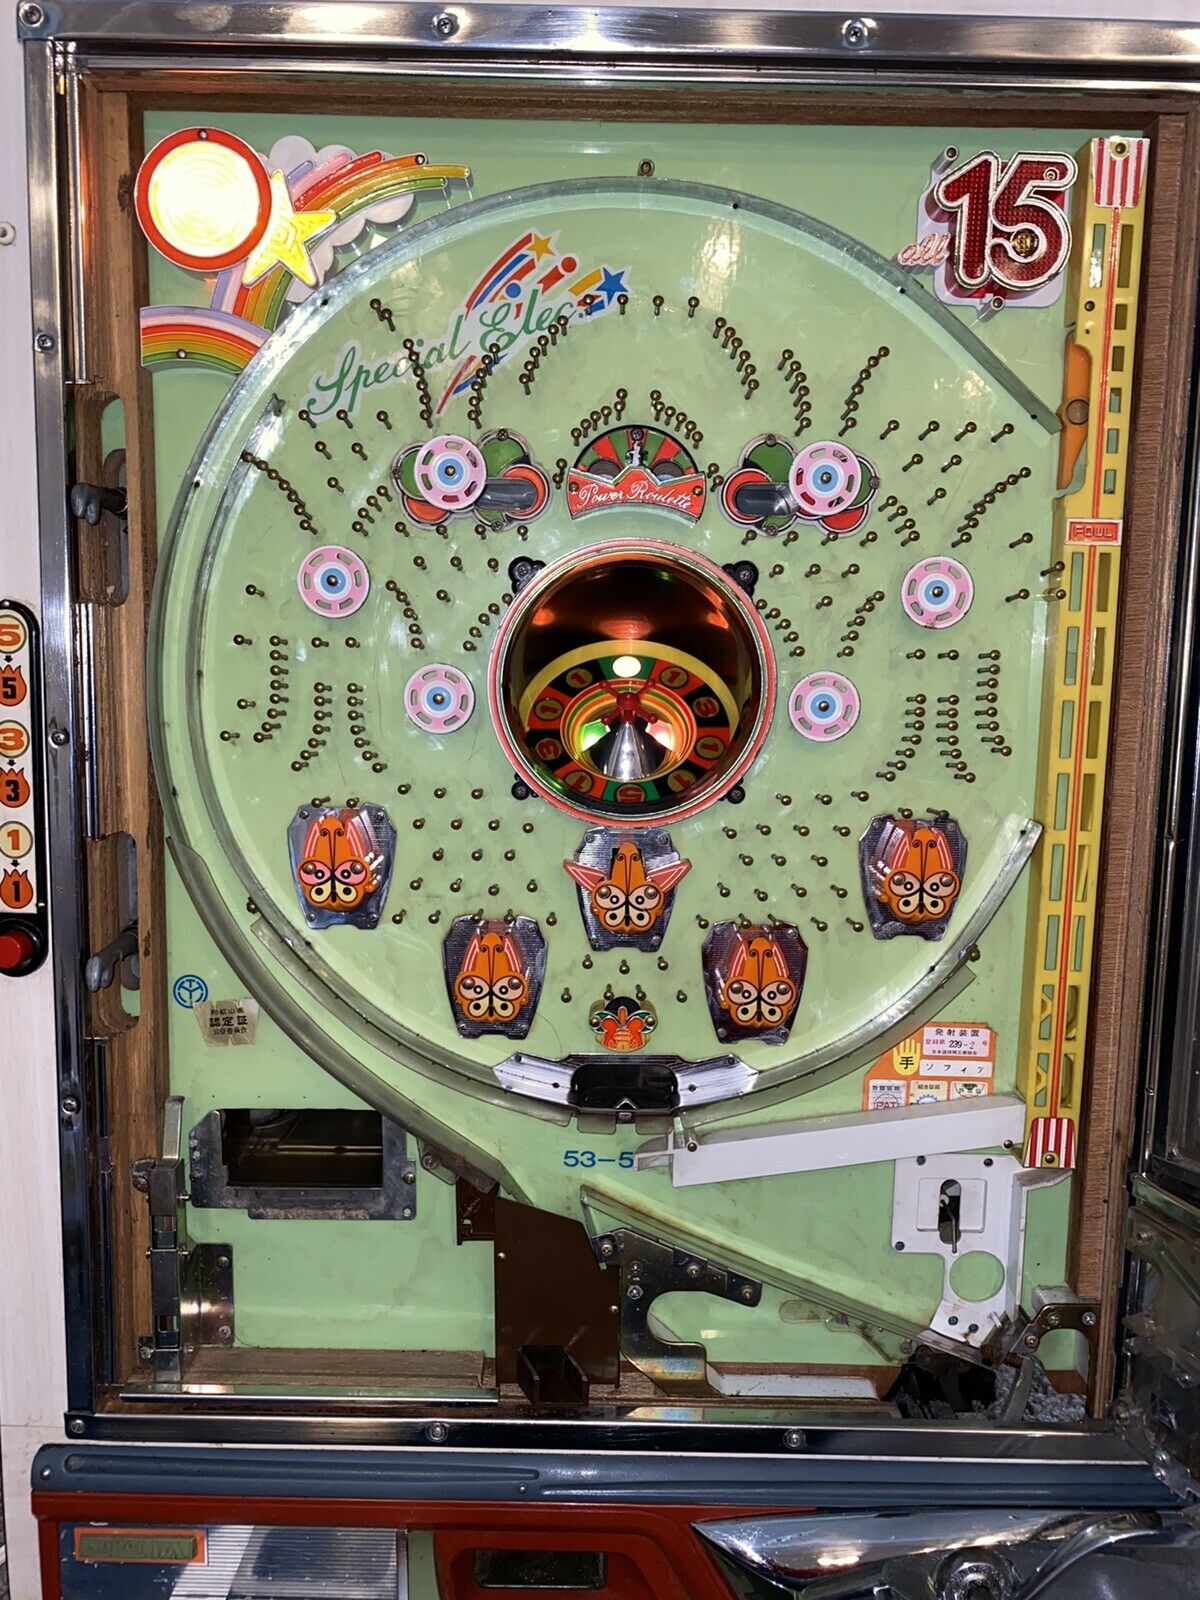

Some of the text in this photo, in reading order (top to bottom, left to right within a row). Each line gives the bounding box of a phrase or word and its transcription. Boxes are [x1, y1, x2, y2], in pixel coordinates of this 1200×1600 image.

[935, 150, 1078, 292] 15
[577, 480, 693, 509] Power Roulette
[1073, 525, 1114, 537] FOUL
[2, 677, 16, 699] 5
[0, 728, 24, 750] 3
[5, 779, 20, 801] 3
[7, 829, 20, 850] 1
[12, 880, 20, 902] 1
[900, 1056, 914, 1069] 手
